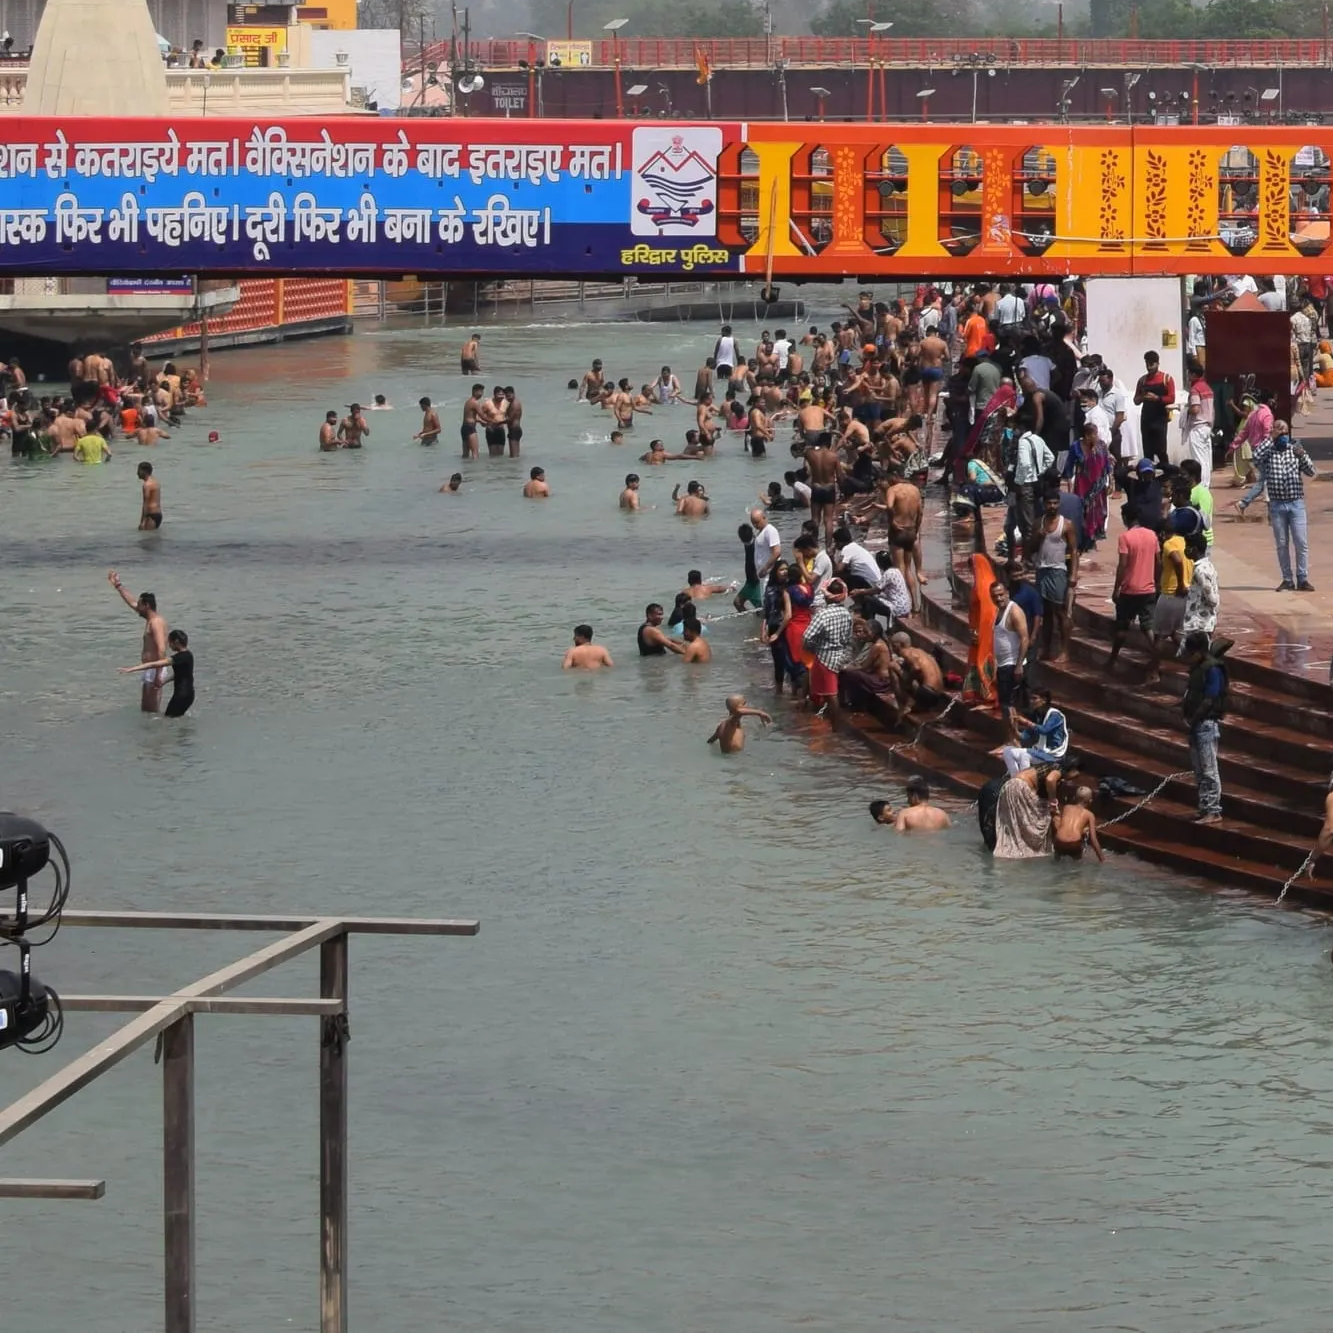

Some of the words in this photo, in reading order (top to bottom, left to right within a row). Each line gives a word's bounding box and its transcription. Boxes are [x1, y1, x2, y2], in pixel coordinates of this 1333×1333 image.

[264, 31, 278, 44] जी
[494, 97, 525, 109] TOILET
[44, 129, 69, 178] से
[74, 128, 180, 182] कतराइये
[245, 126, 376, 177] वैक्सिनेशन
[382, 129, 411, 177] के
[416, 143, 463, 178] बाद
[467, 144, 563, 185] इतराइए
[54, 192, 104, 243] फिर
[108, 192, 140, 243] भी
[245, 191, 286, 261] दूरी
[292, 192, 342, 243] फिर
[346, 192, 378, 243] भी
[384, 209, 432, 244] बना
[438, 195, 465, 245] के
[620, 243, 678, 265] हरिद्वार
[679, 243, 729, 270] पुलिस
